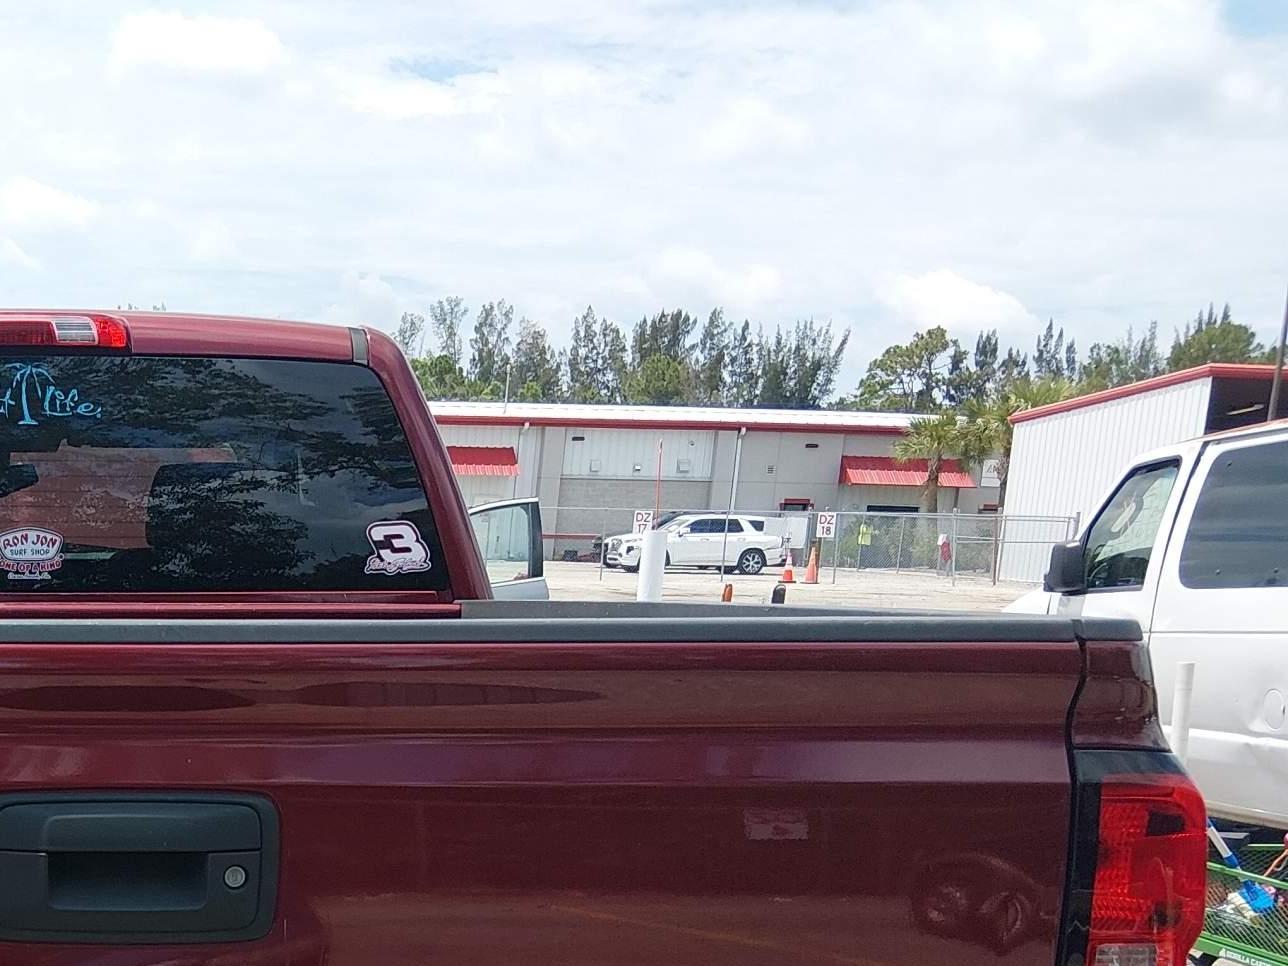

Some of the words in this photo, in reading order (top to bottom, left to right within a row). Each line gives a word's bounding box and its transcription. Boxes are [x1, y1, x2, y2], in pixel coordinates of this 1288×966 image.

[636, 512, 652, 522] DZ
[819, 515, 833, 525] DZ
[638, 524, 648, 533] 17
[821, 526, 831, 535] 18
[3, 533, 28, 550] RON
[32, 534, 58, 548] JON
[368, 522, 428, 562] 3
[9, 548, 27, 556] SURF
[30, 548, 50, 556] SHOP
[18, 562, 31, 572] OF
[40, 560, 62, 571] KIND
